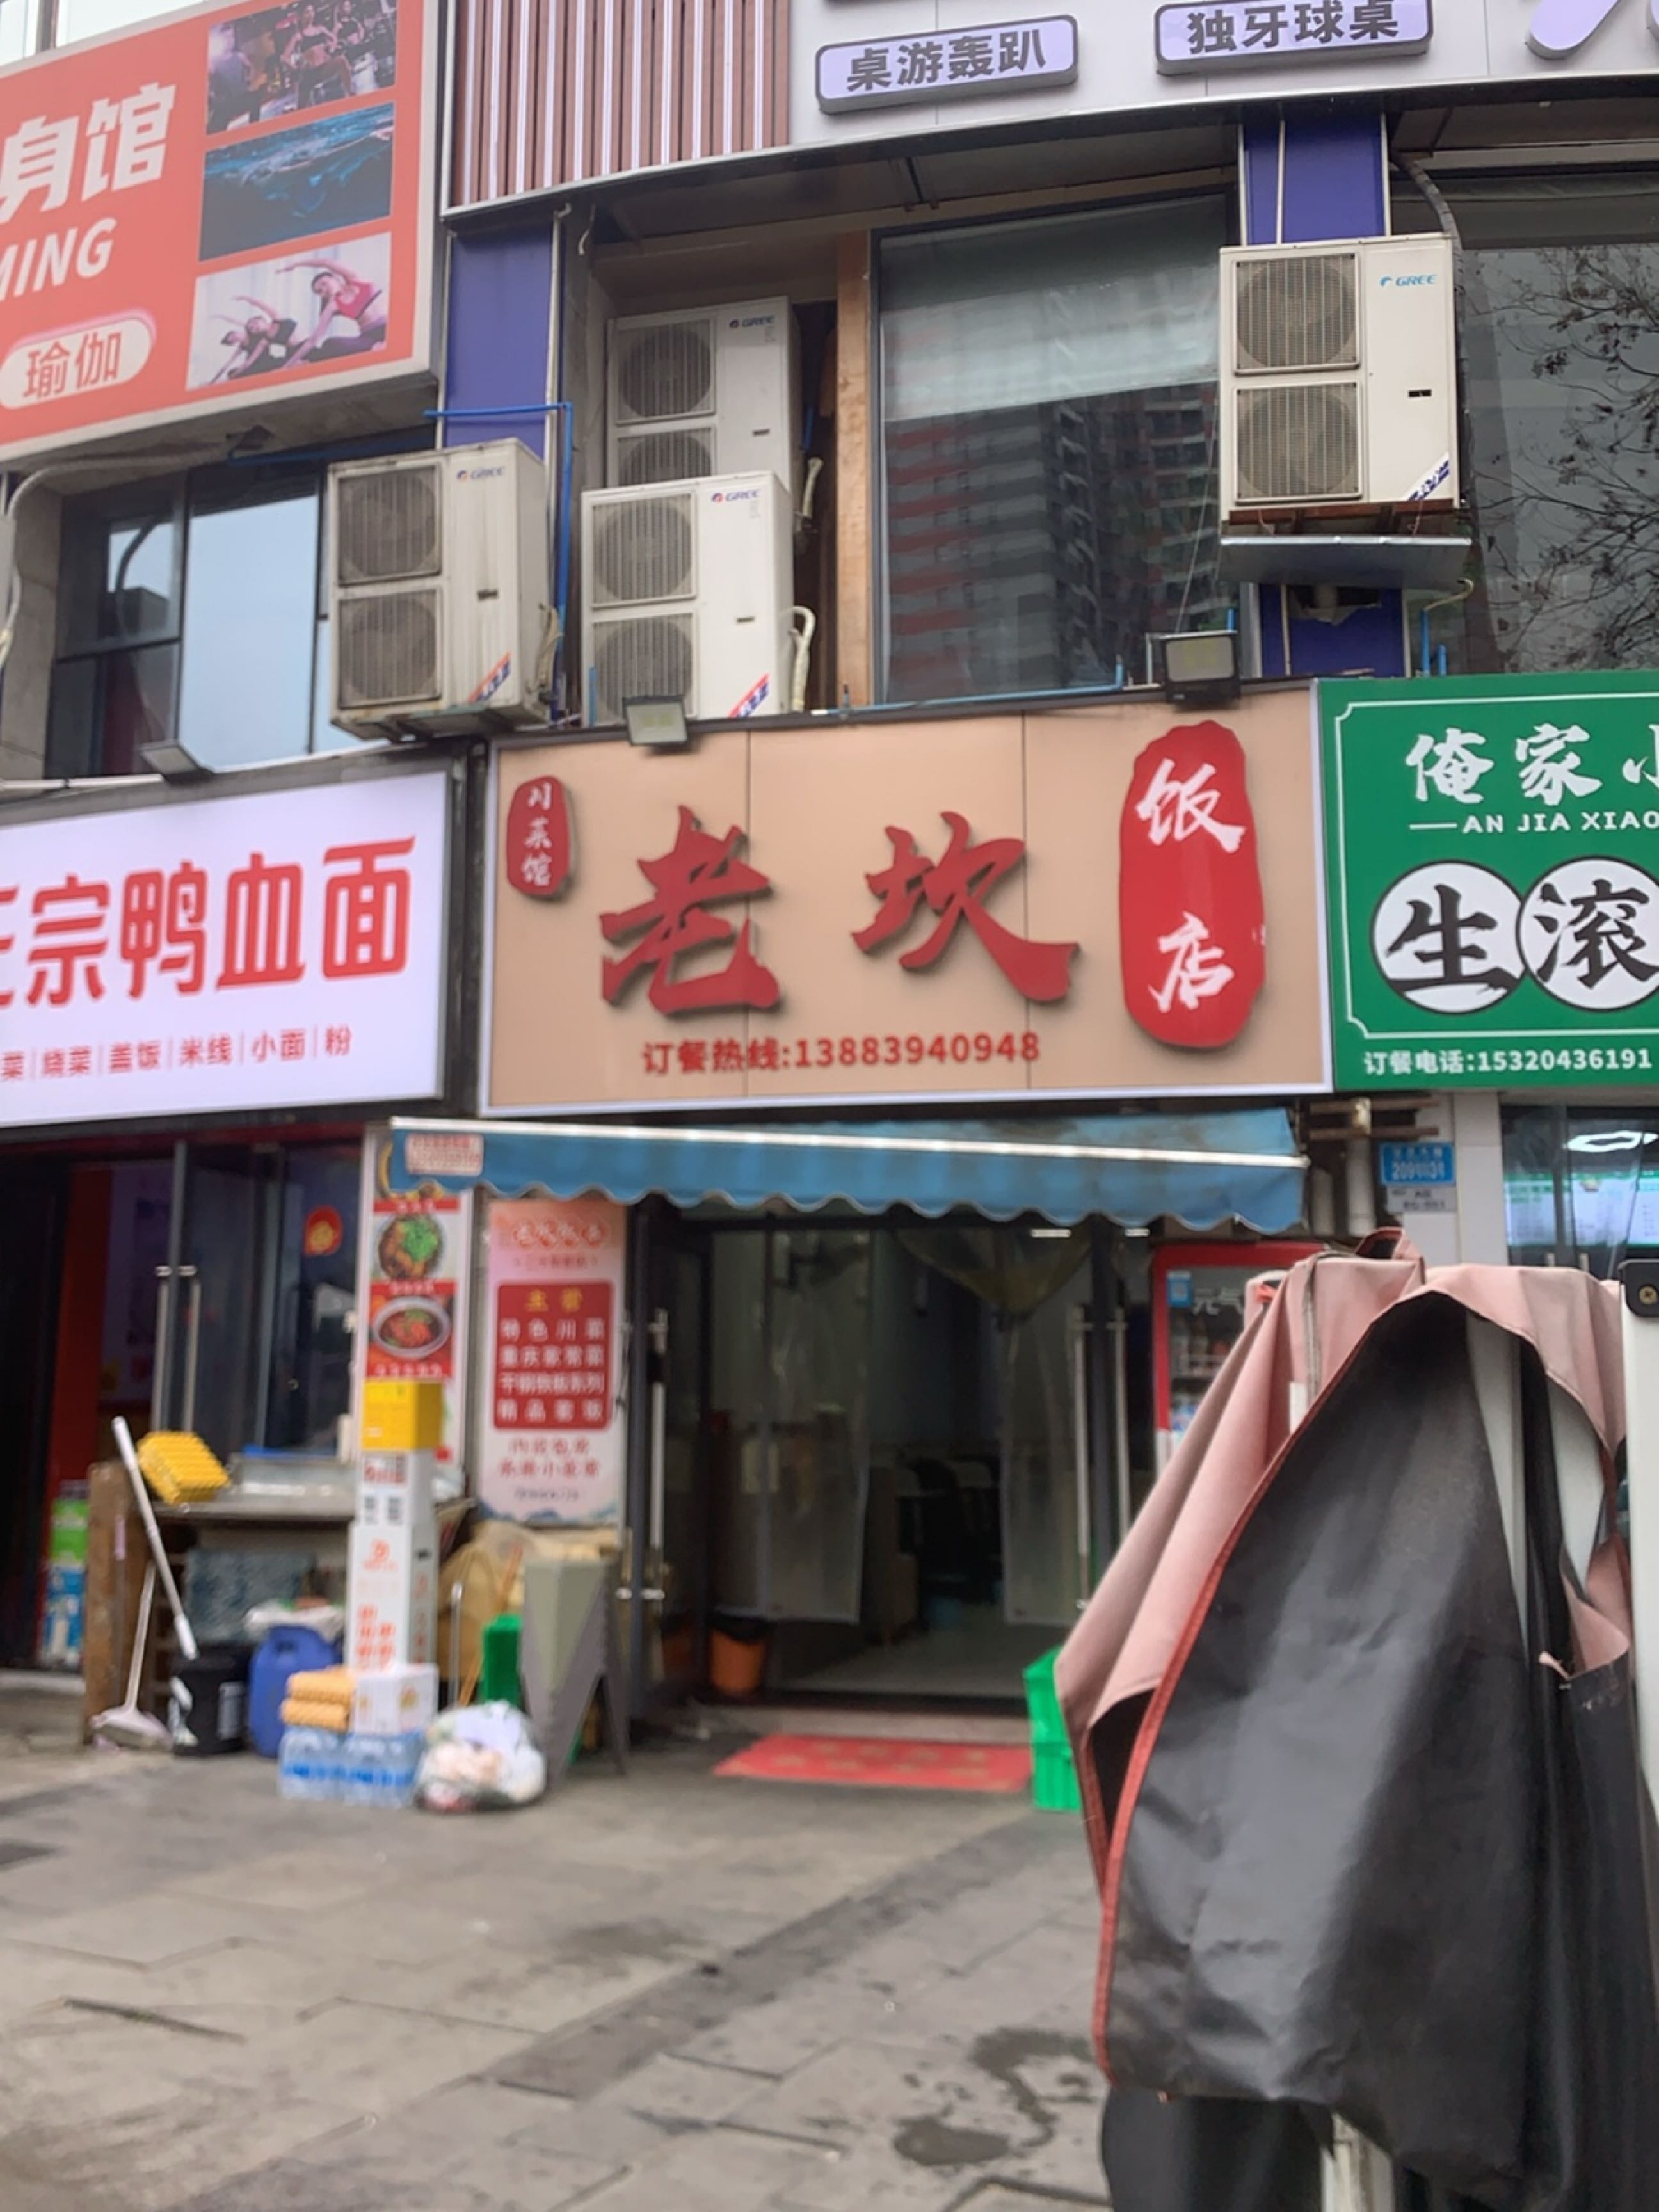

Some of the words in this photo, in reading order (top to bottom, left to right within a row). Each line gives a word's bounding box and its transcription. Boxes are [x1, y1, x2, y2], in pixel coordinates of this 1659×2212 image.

[1187, 0, 1399, 54] 独牙球桌
[847, 29, 1046, 92] 桌游轰趴
[1396, 274, 1437, 286] GREE
[23, 332, 122, 398] 瑜伽
[521, 782, 552, 886] 川菜馆
[1462, 815, 1504, 833] AN
[1516, 812, 1571, 831] JIA
[600, 805, 1079, 1014] 老坎
[1134, 758, 1246, 1011] 饭店
[1387, 879, 1659, 994] 生滚
[109, 1039, 161, 1074] 盖饭
[179, 1032, 233, 1068] 米线
[252, 1028, 306, 1064] 小面
[325, 1023, 352, 1057] 粉
[643, 1032, 1040, 1075] 订餐热线:13883940948
[1364, 1048, 1652, 1075] 订餐电话:15320436191
